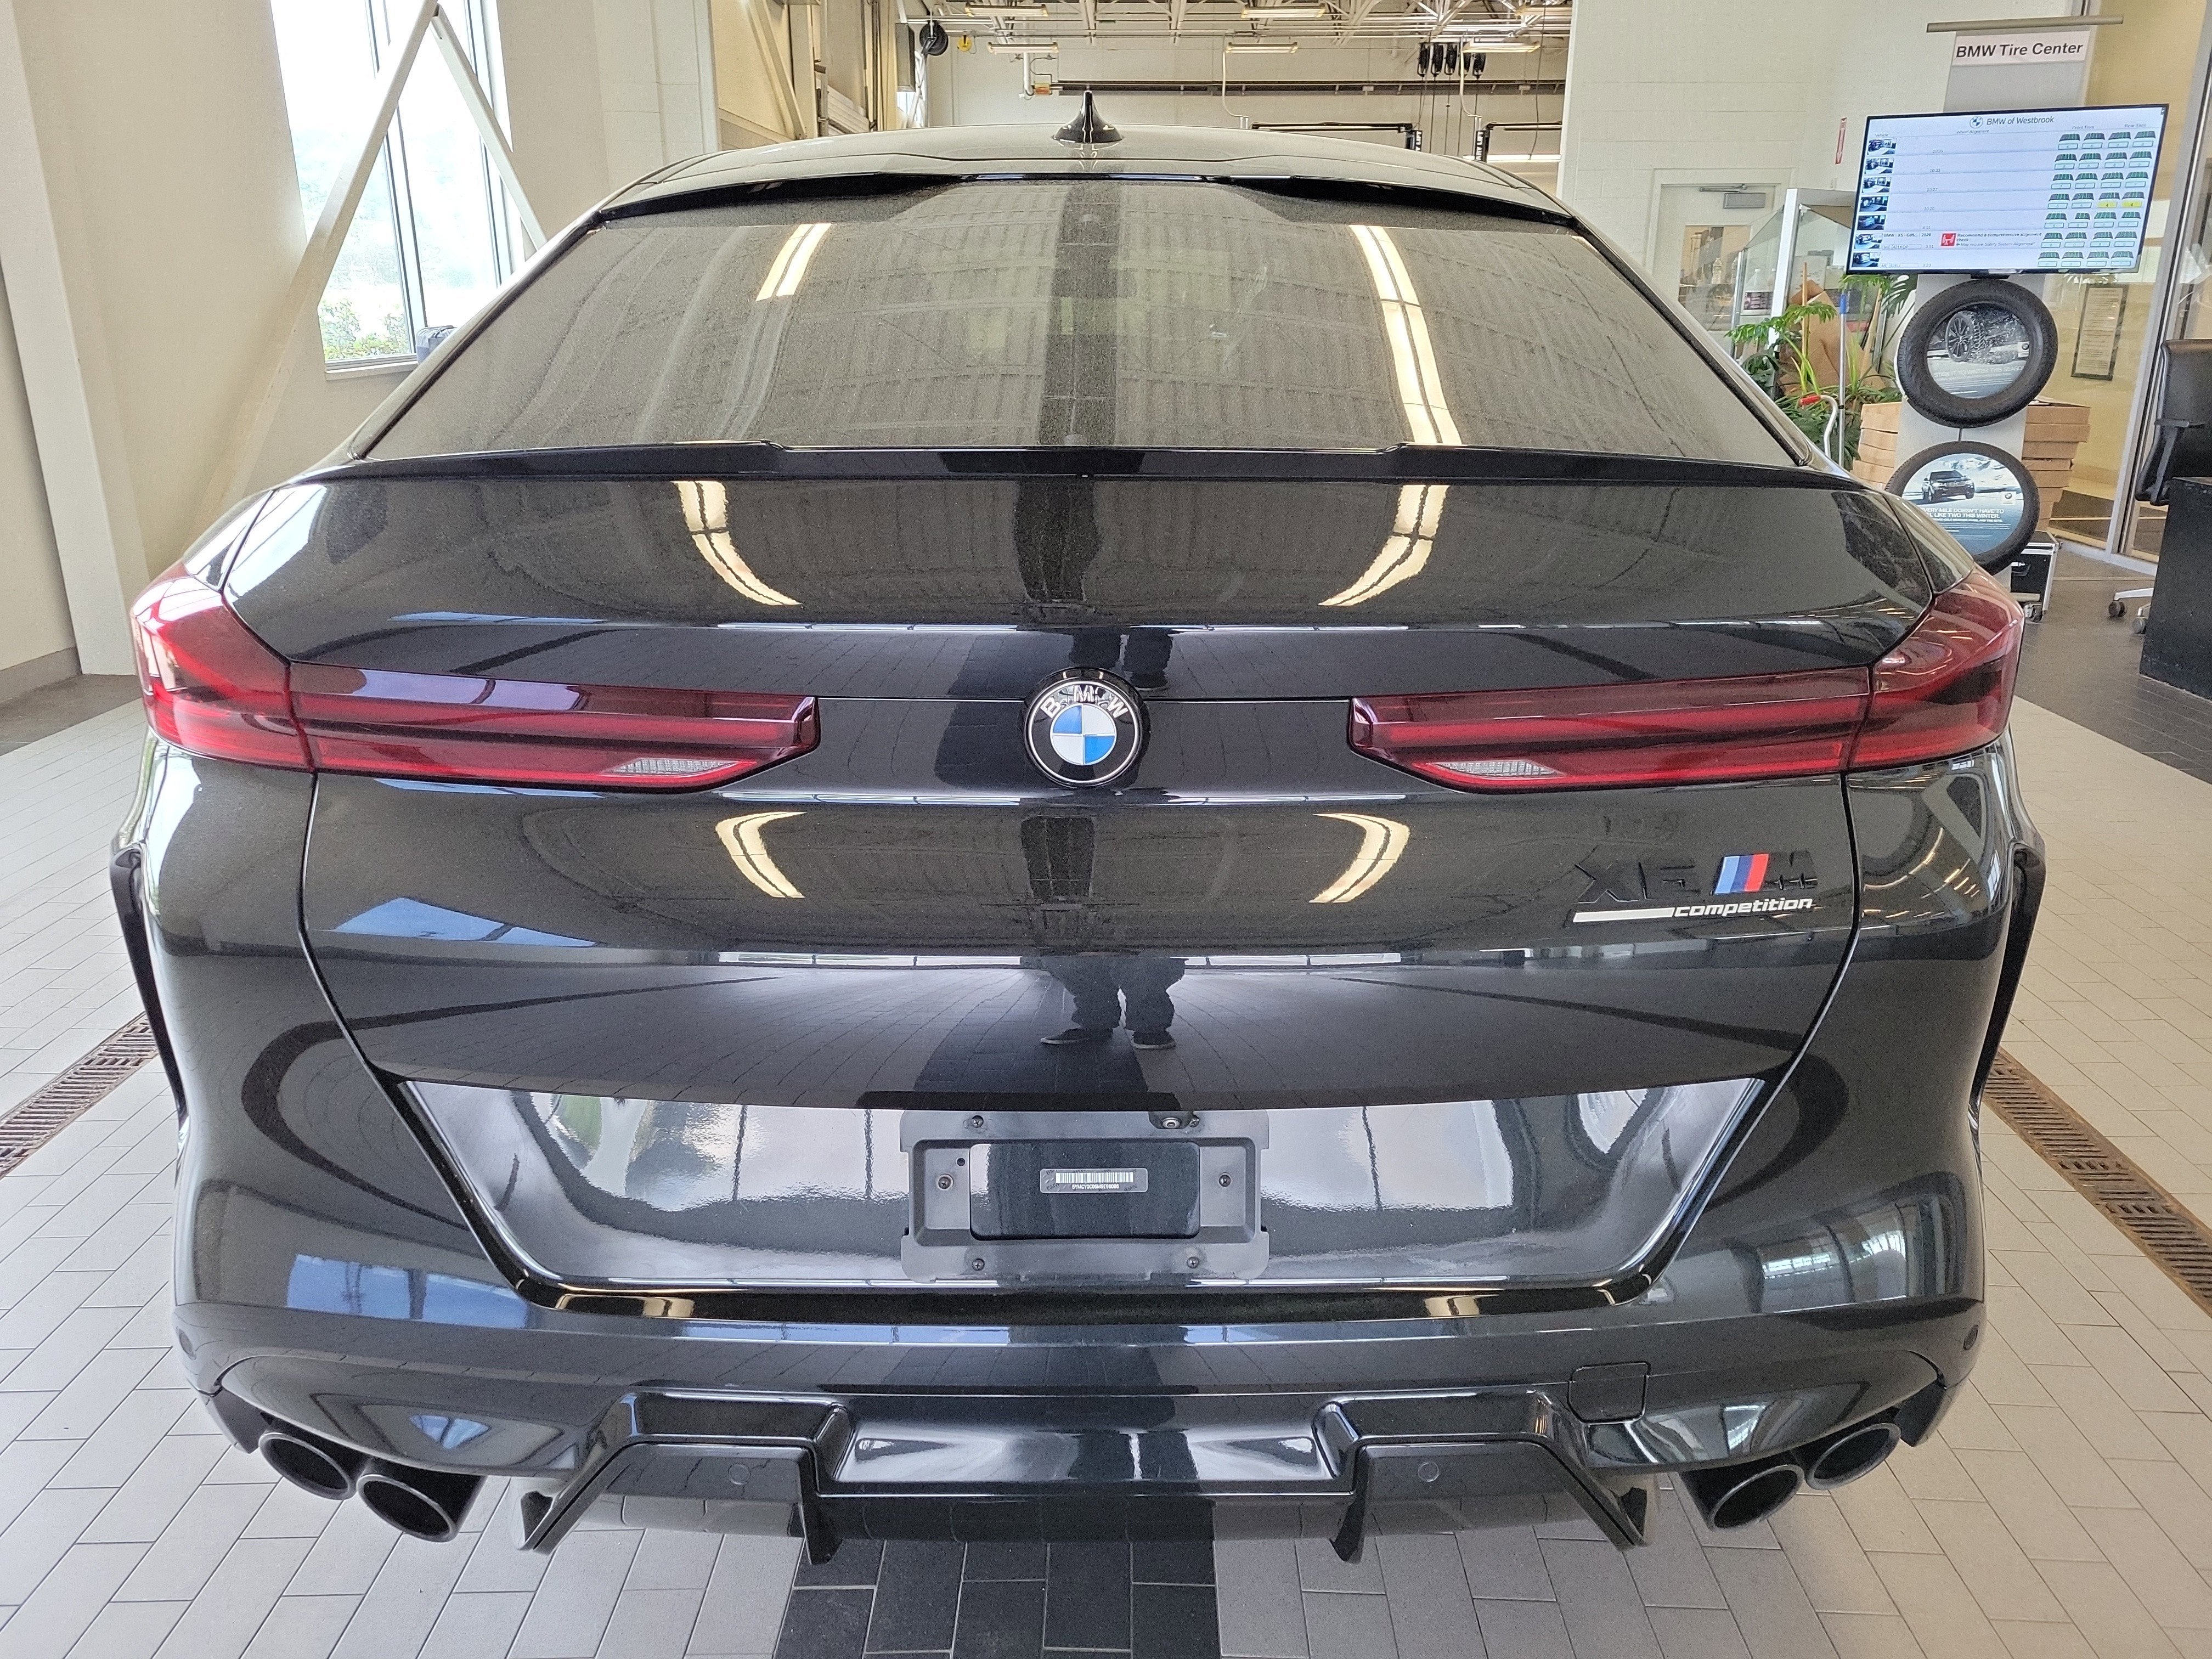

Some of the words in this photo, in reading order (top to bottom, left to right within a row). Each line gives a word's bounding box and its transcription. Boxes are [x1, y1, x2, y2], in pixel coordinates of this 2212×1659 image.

[1956, 44, 1996, 58] BMW
[1999, 44, 2028, 57] Tire
[2032, 42, 2084, 55] Center
[1987, 117, 2006, 126] BMW
[2007, 116, 2015, 125] of
[2017, 115, 2055, 125] Westbrook
[1040, 684, 1129, 719] BMW
[1673, 897, 1814, 918] competition
